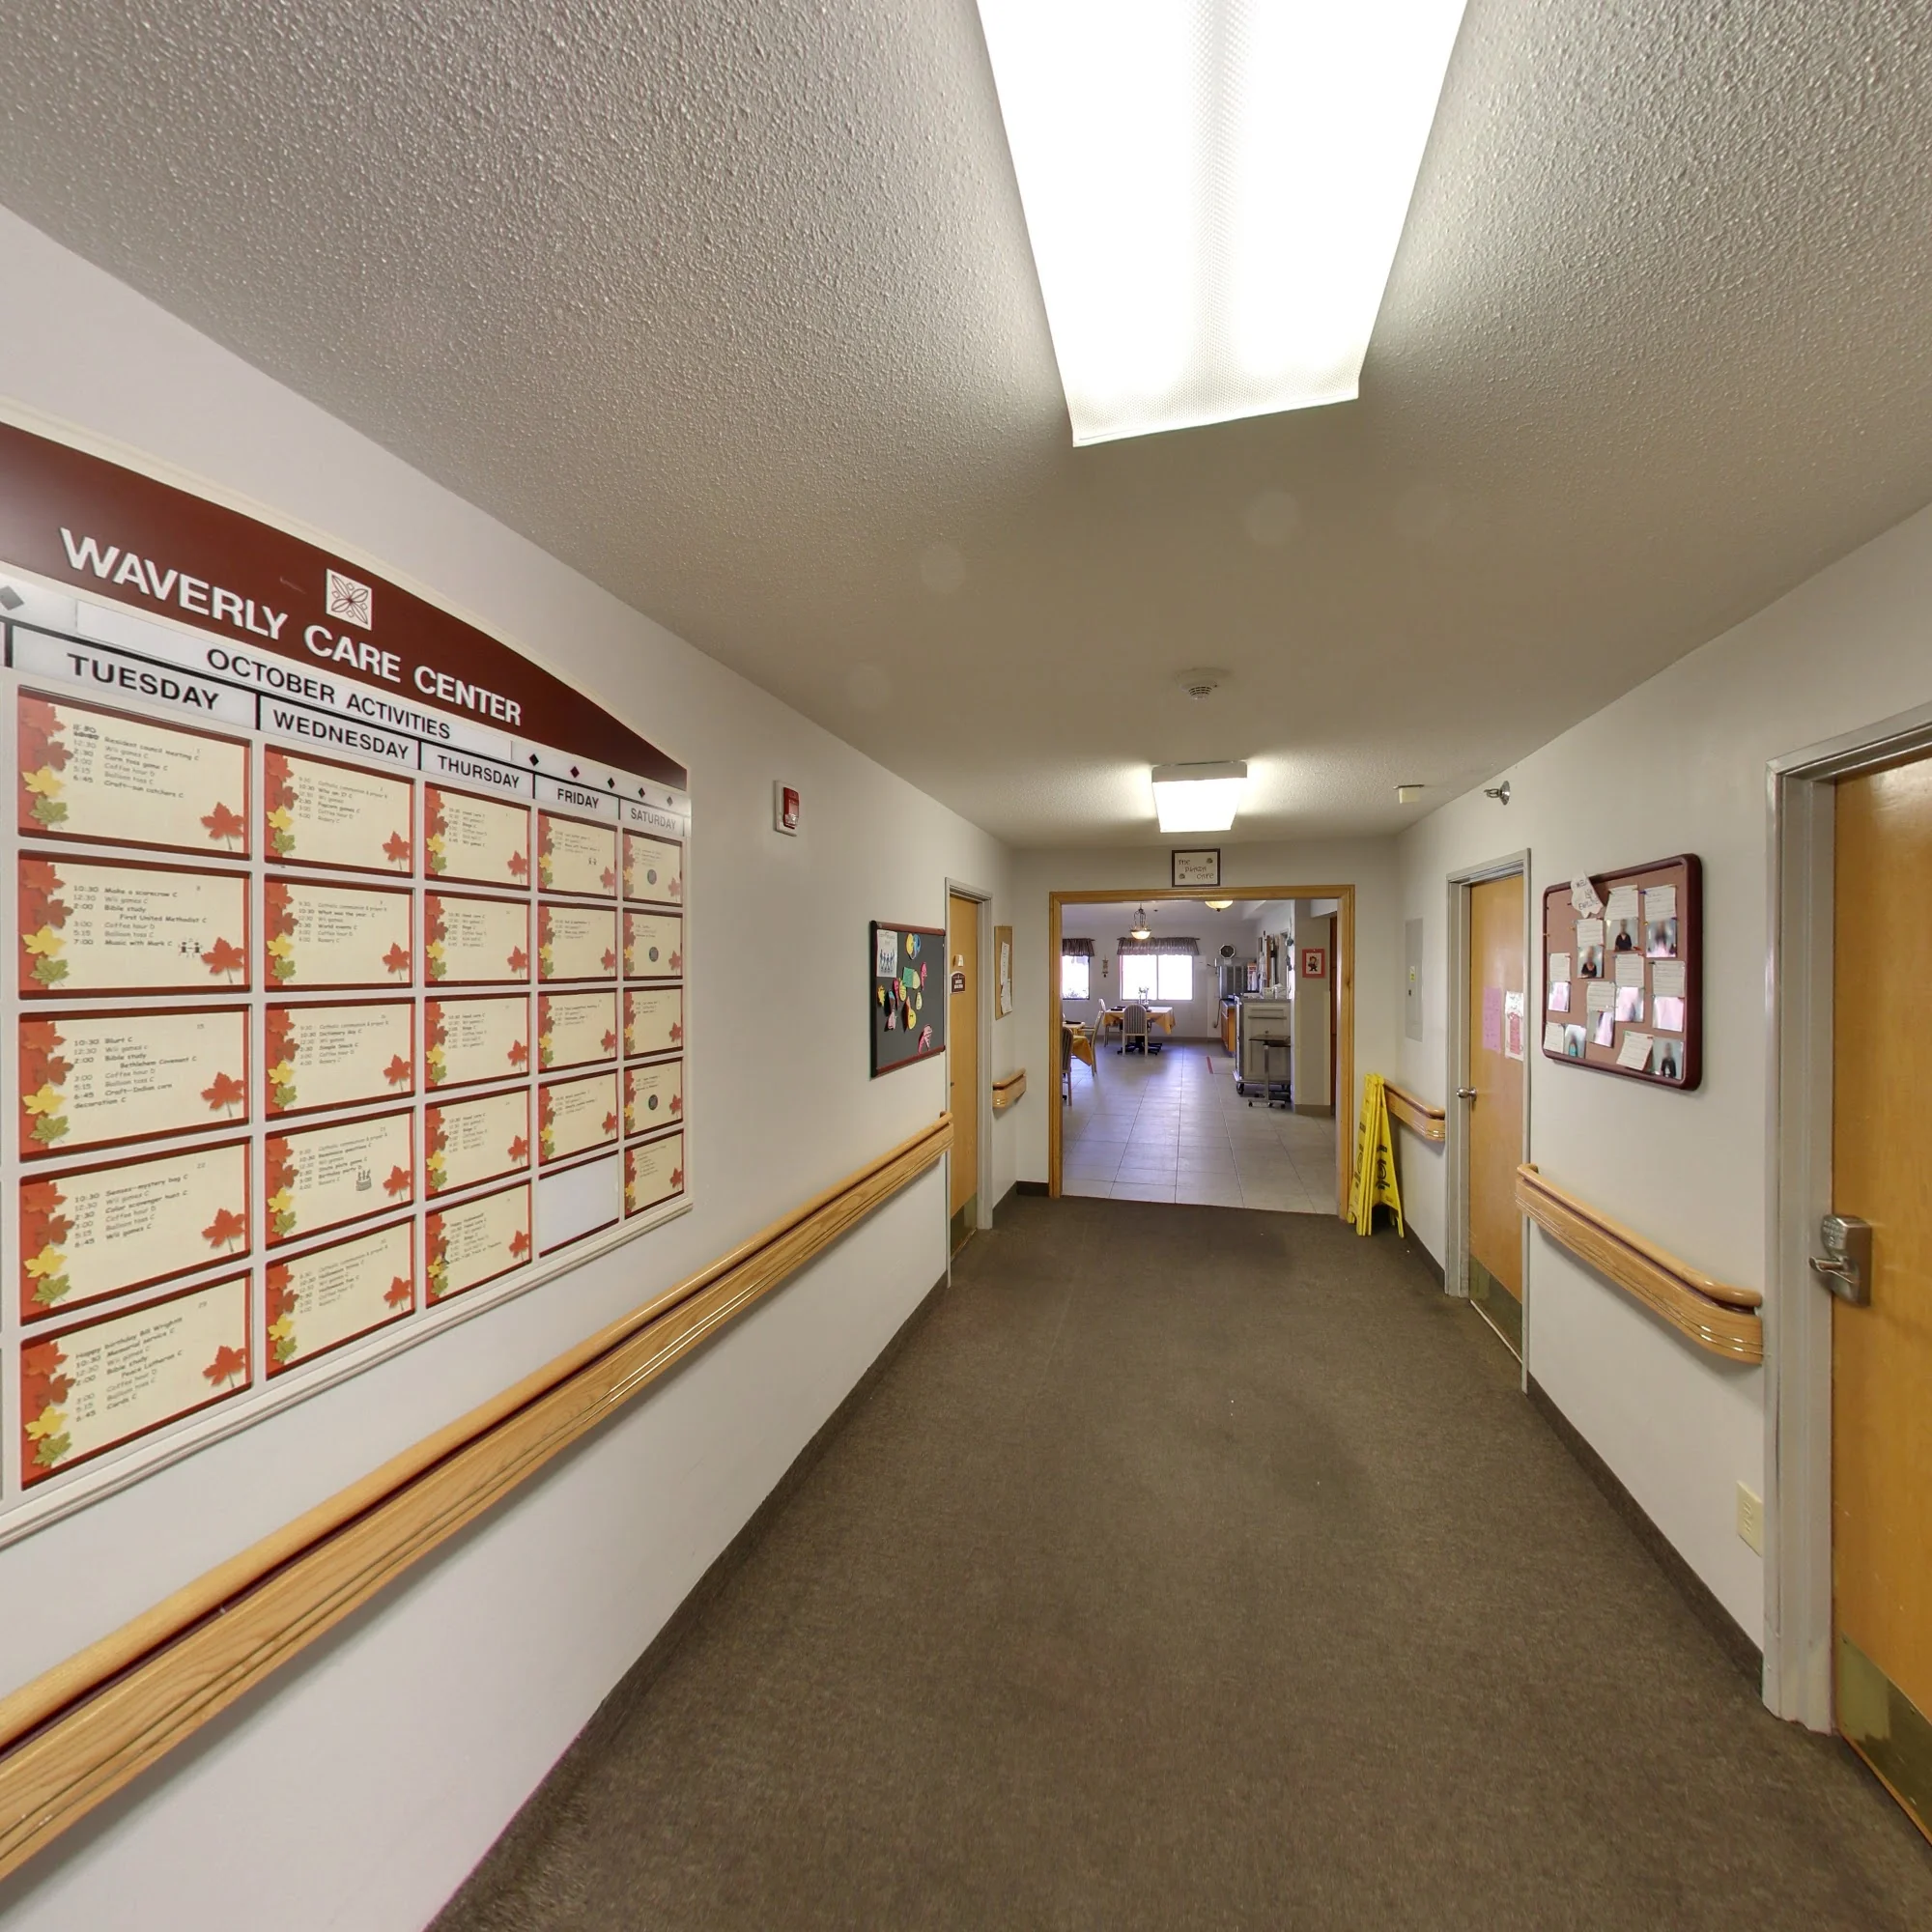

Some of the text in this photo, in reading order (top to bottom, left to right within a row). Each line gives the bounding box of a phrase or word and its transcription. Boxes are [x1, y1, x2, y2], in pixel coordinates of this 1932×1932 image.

[60, 526, 522, 725] WAVERLY CARE CENTER
[68, 652, 218, 710] TUESDAY
[207, 648, 451, 740] OCTOBER ACTIVITIES
[272, 709, 409, 760] WEDNESDAY
[438, 754, 519, 788] THURSDAY
[557, 788, 599, 810] FRIDAY
[631, 808, 676, 830] SATURDAY
[121, 1060, 156, 1068] Bethlehem
[74, 1098, 118, 1109] decoration
[74, 1193, 99, 1203] 10:30
[75, 1211, 95, 1220] 2:30
[106, 1213, 131, 1222] Coffee
